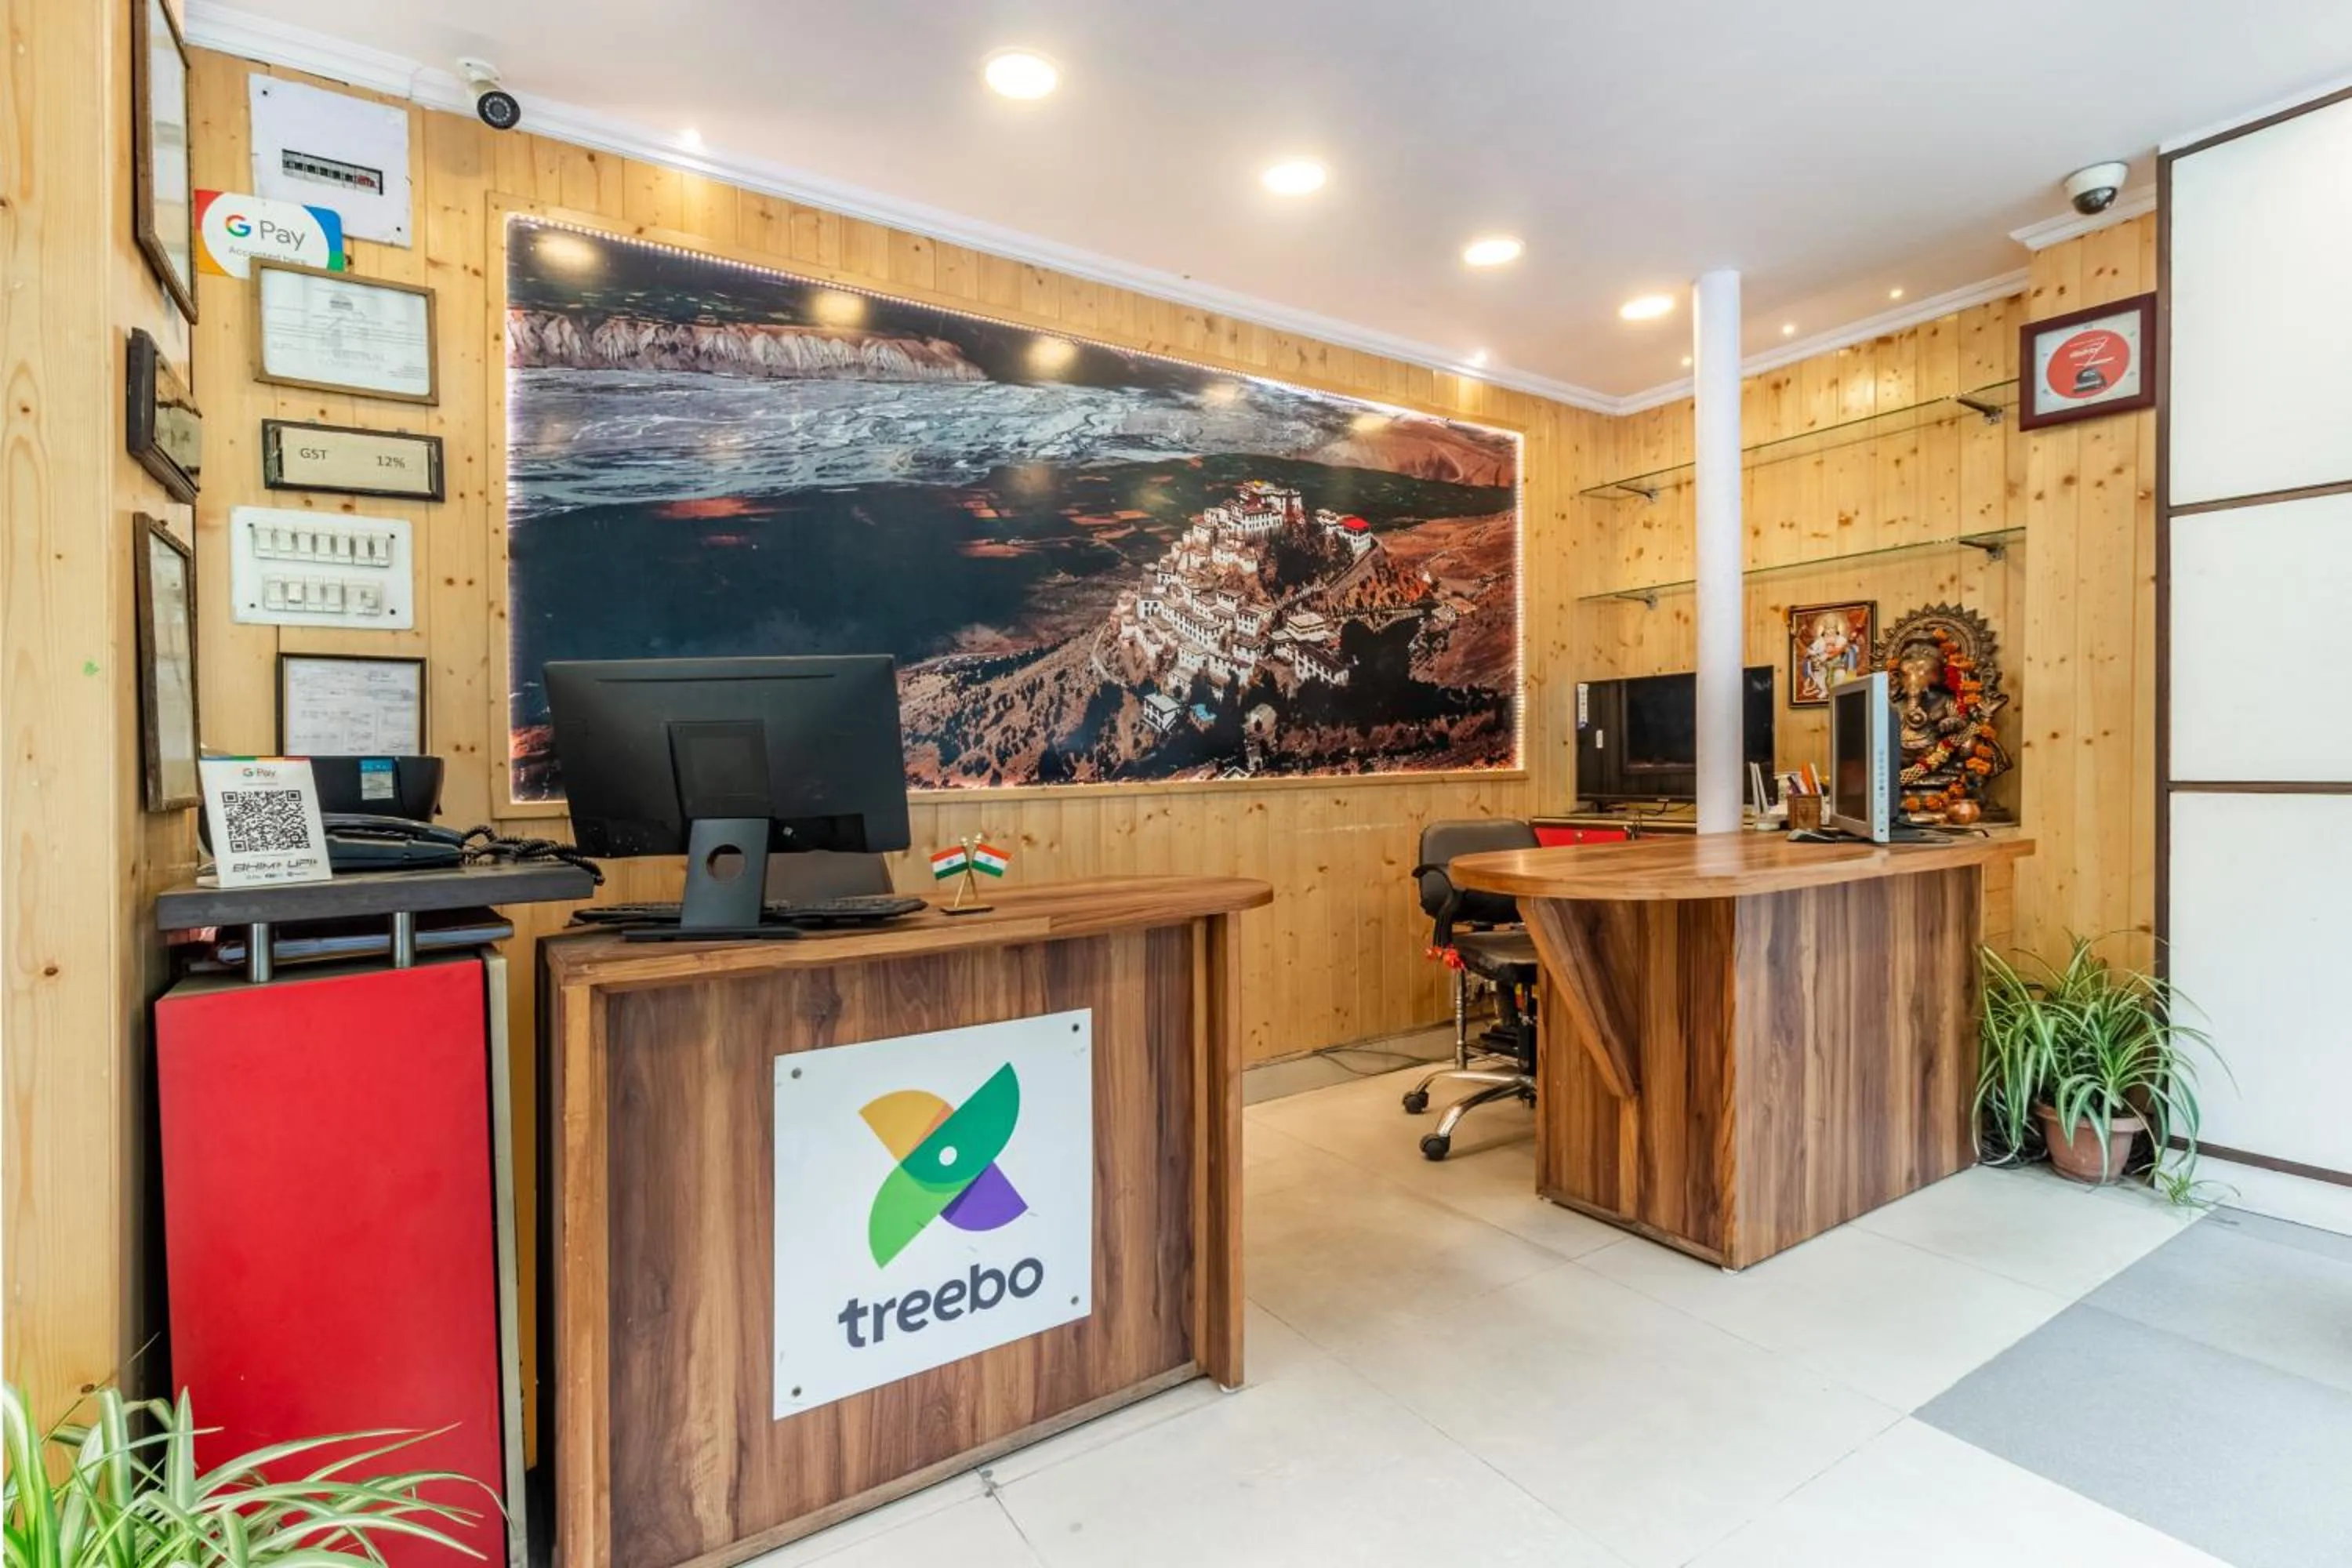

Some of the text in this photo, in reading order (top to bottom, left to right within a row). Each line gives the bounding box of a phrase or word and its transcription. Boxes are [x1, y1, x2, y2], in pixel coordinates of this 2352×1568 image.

[225, 214, 305, 251] G Pay
[300, 448, 405, 468] GST 12%
[838, 1257, 1044, 1348] treebo
